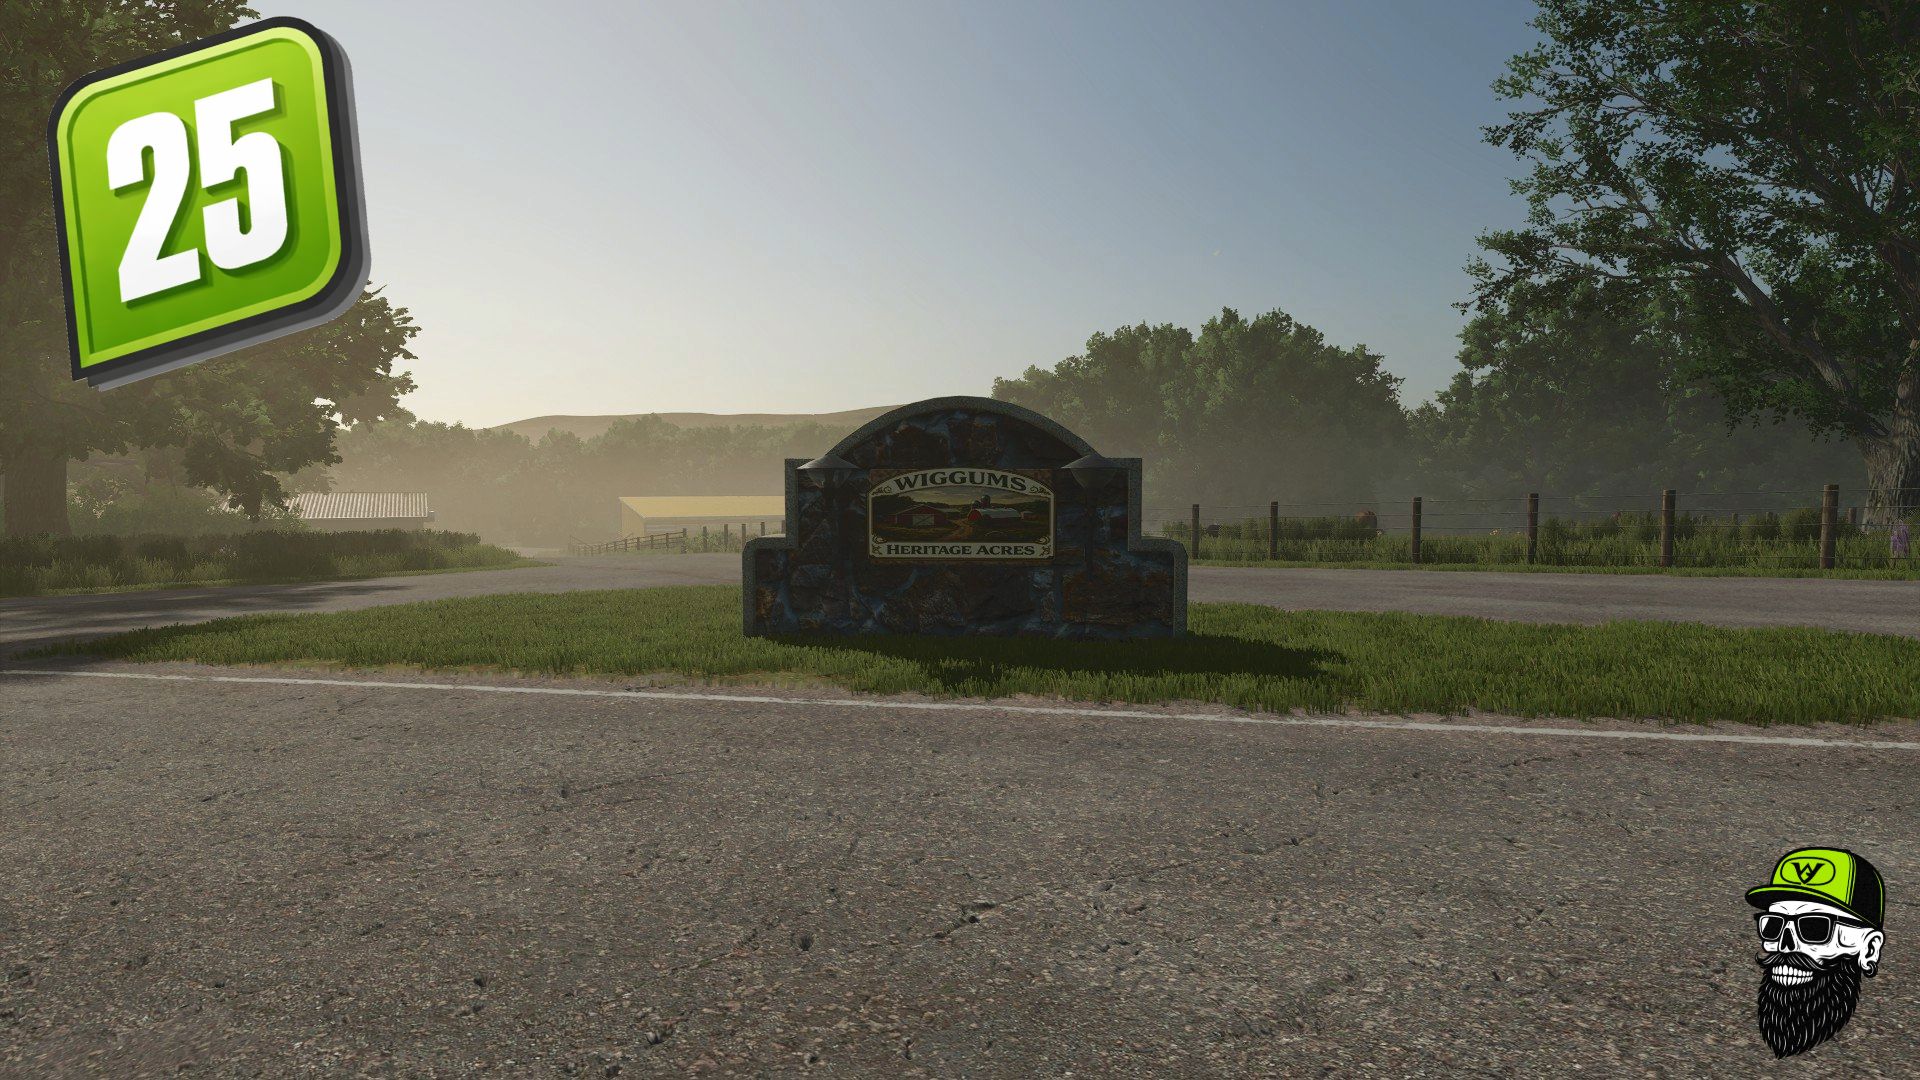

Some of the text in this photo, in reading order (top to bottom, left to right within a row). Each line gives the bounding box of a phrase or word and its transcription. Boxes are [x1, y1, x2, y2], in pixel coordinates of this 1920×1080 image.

[893, 470, 1027, 492] WIGGUMS
[886, 544, 1035, 556] HERITAGE ACRES
